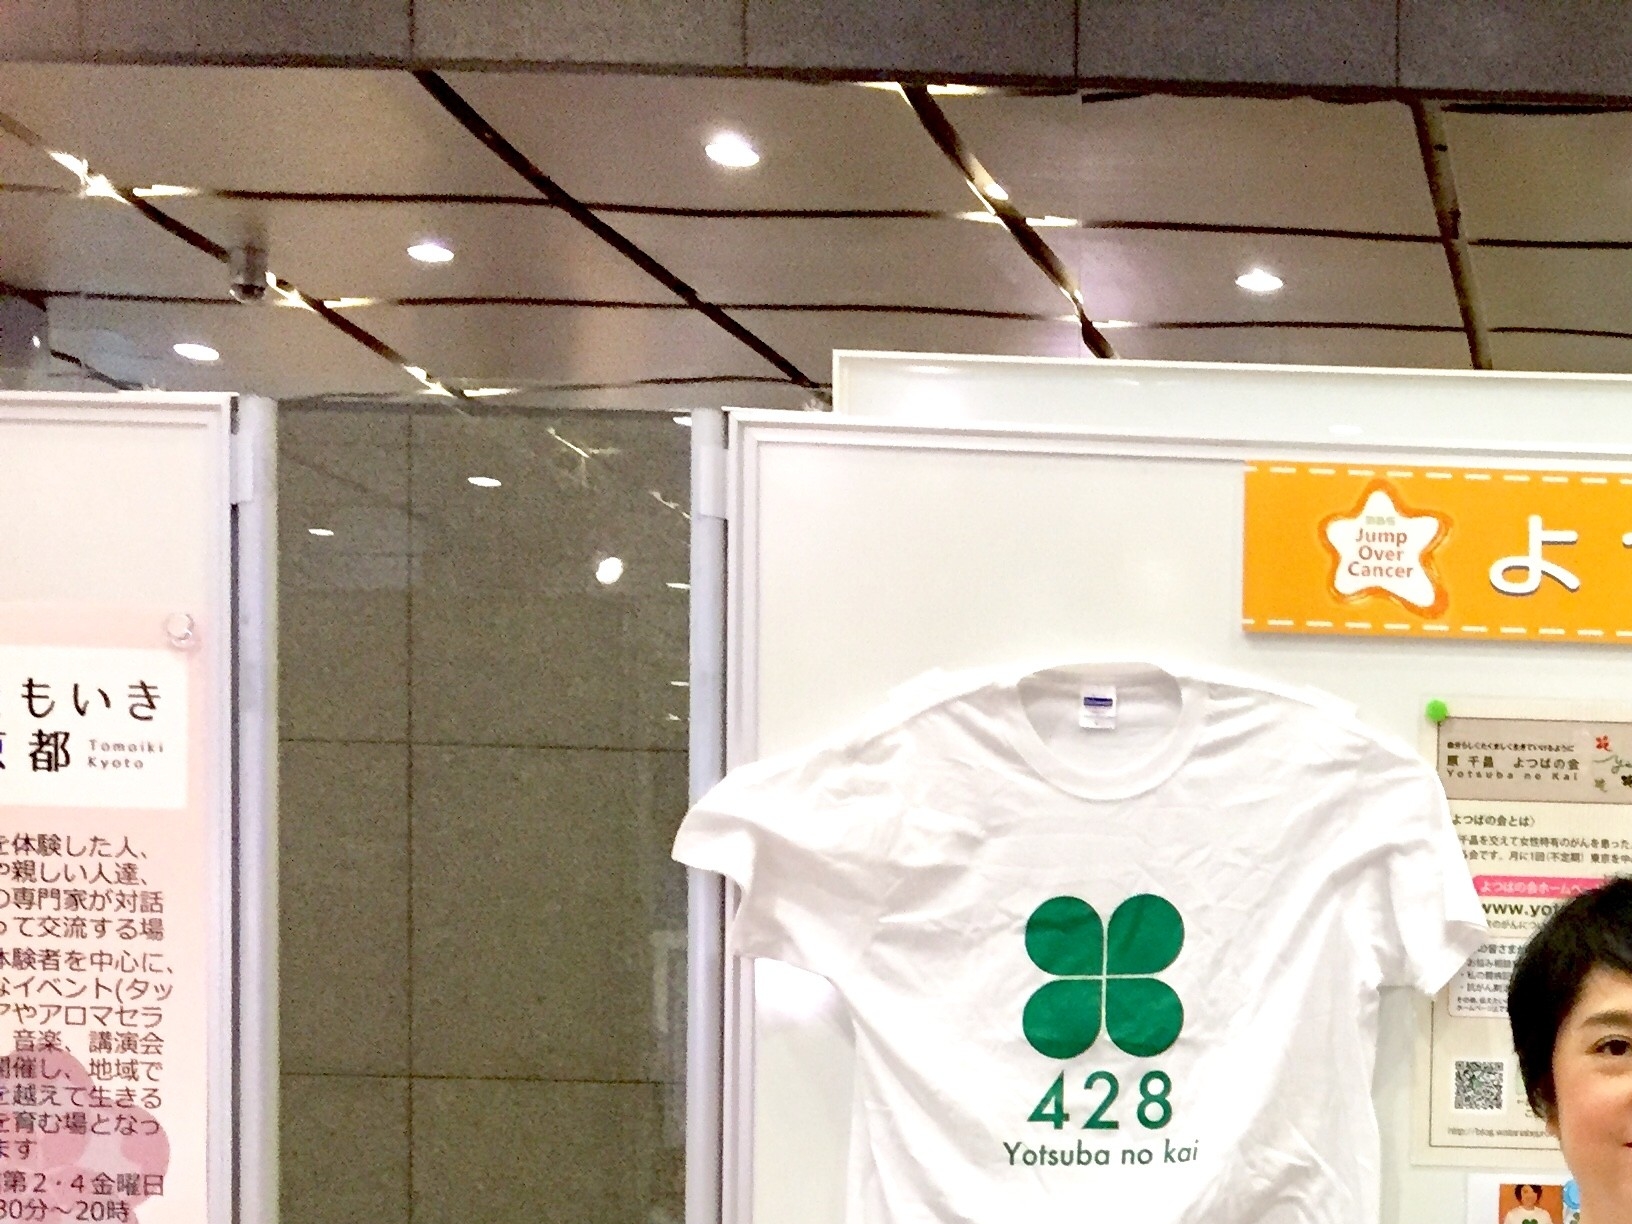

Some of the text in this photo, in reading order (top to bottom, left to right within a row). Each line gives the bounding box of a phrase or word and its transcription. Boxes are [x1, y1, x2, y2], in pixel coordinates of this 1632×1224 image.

[1355, 528, 1408, 546] Jump
[1358, 545, 1404, 561] Over
[1347, 561, 1414, 578] Cancer
[21, 677, 161, 721] もいき
[0, 729, 70, 772] 都
[88, 756, 144, 769] Kyoto
[1027, 1070, 1172, 1130] 428
[1003, 1139, 1199, 1167] Yotsuba no kai
